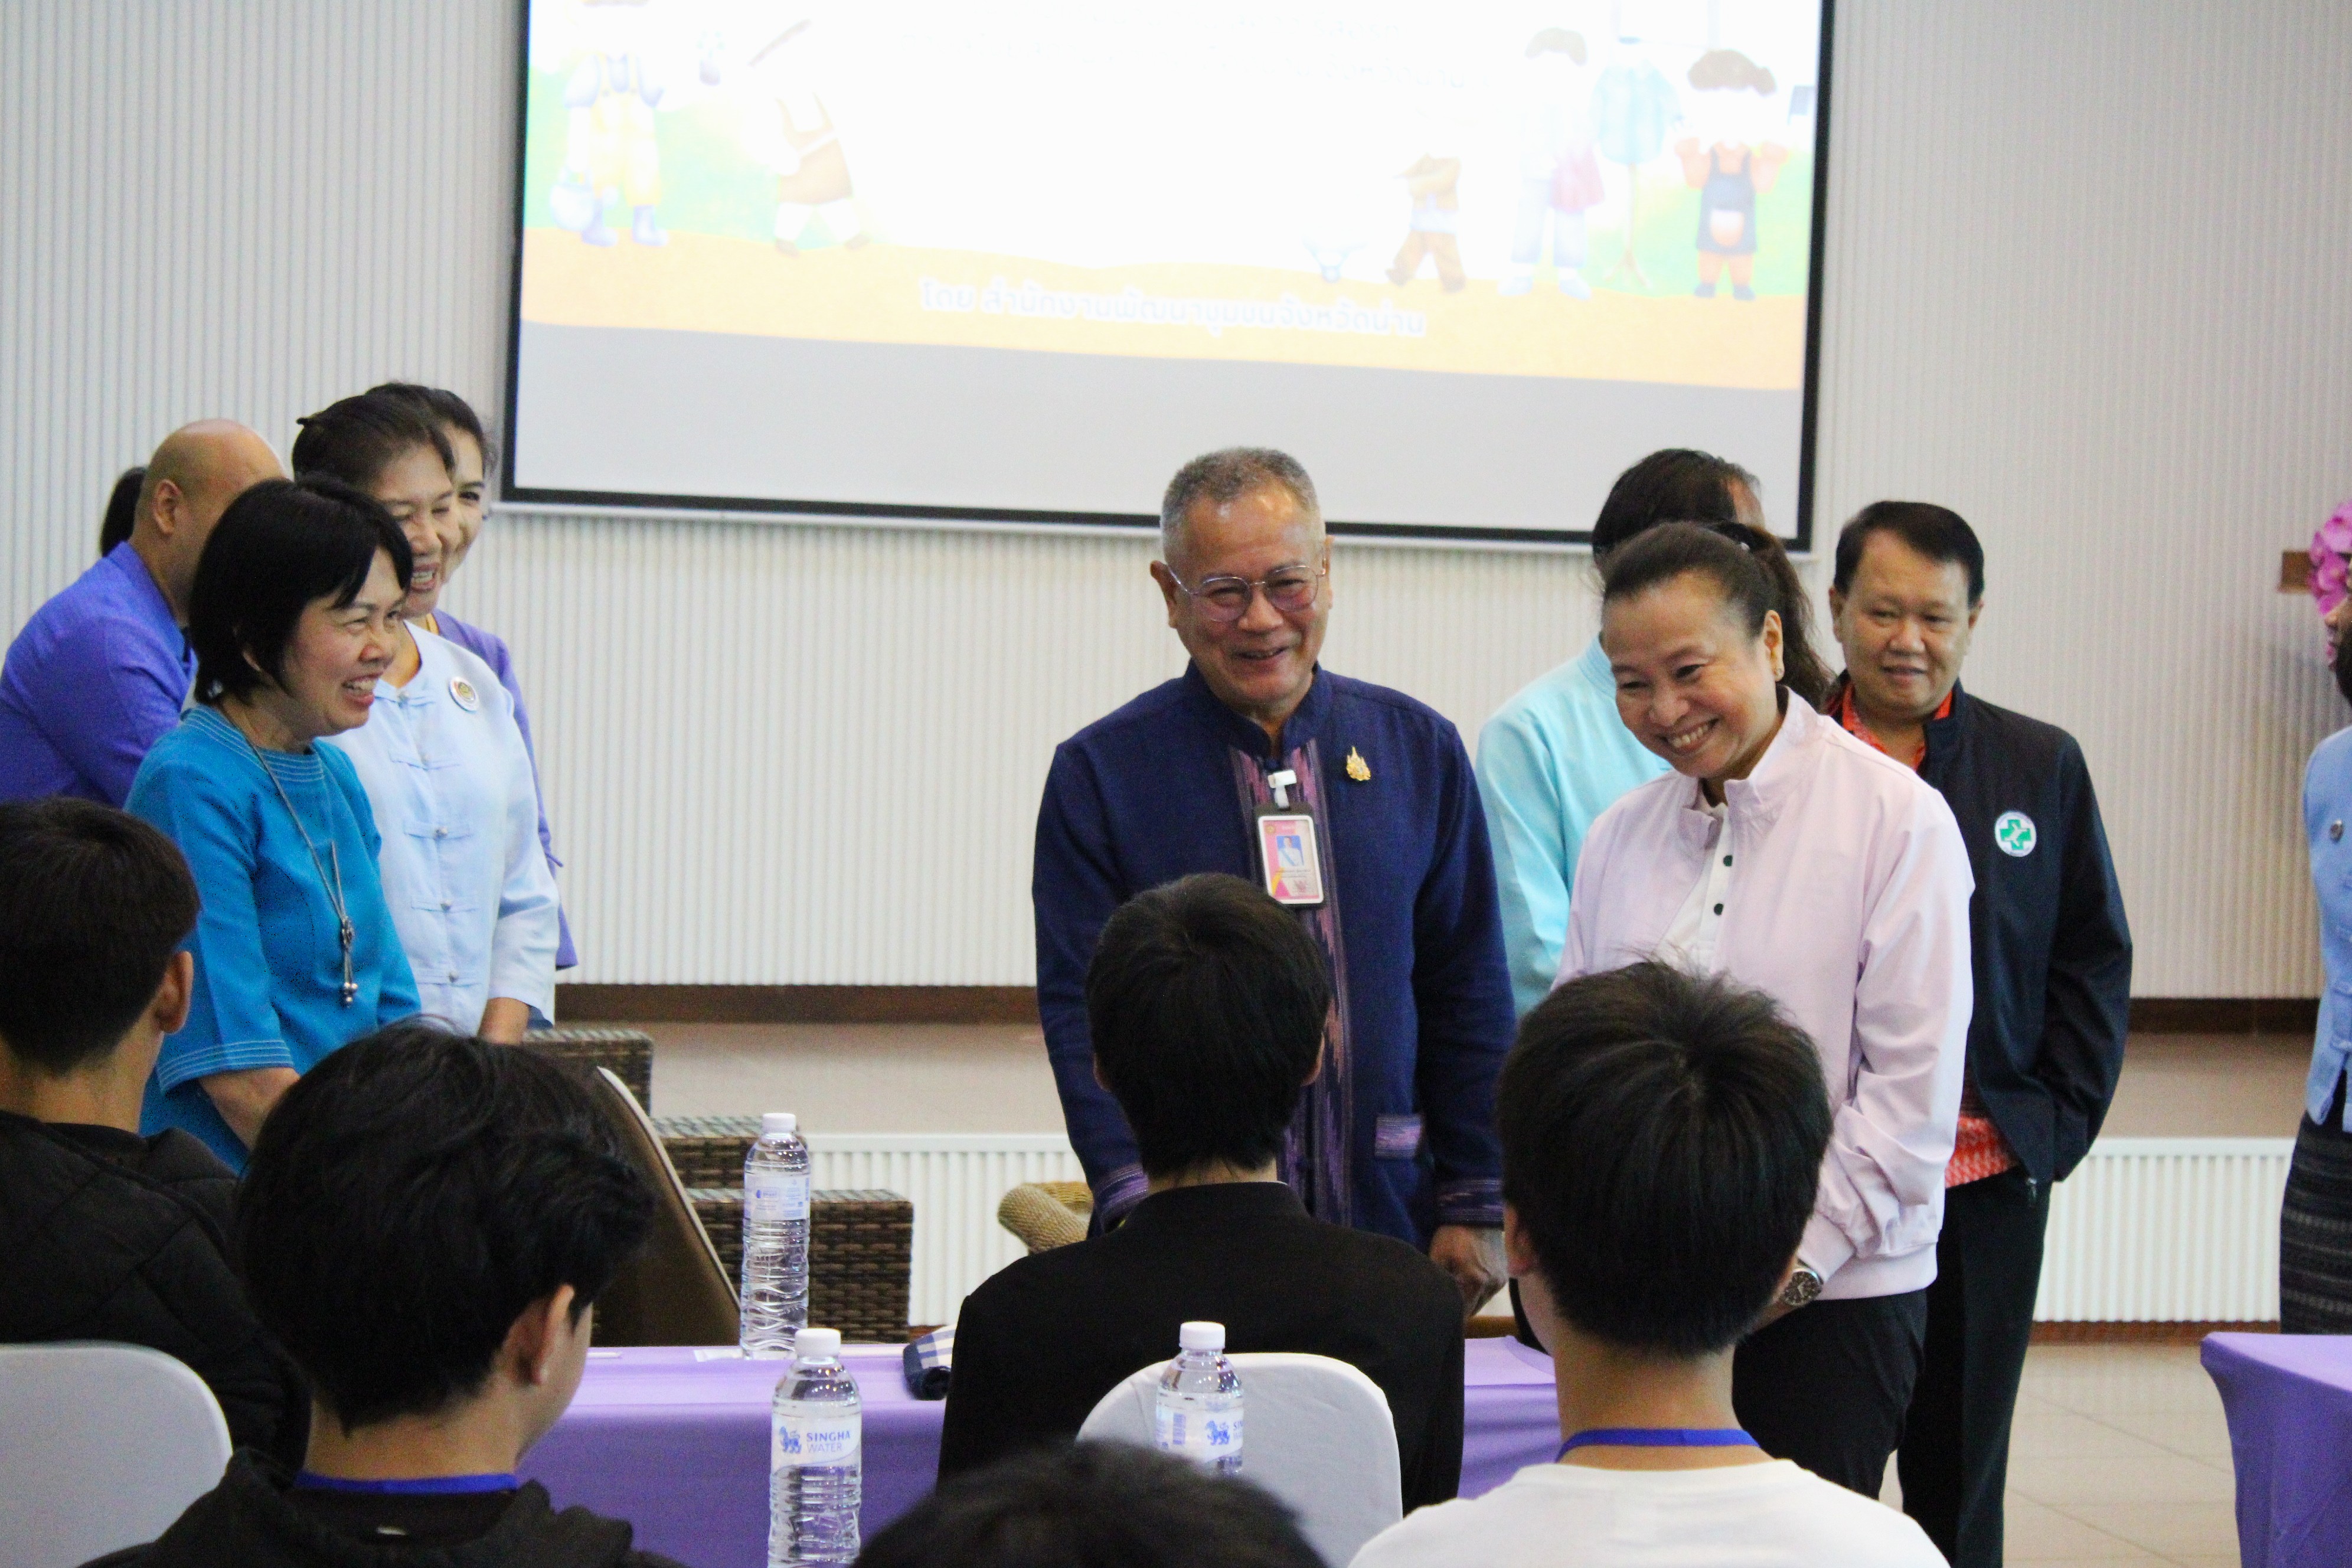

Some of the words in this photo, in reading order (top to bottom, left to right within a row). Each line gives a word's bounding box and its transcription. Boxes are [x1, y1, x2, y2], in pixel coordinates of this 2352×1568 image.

[920, 277, 976, 312] โดย
[806, 1430, 850, 1442] SINGHA
[806, 1442, 842, 1453] WATER
